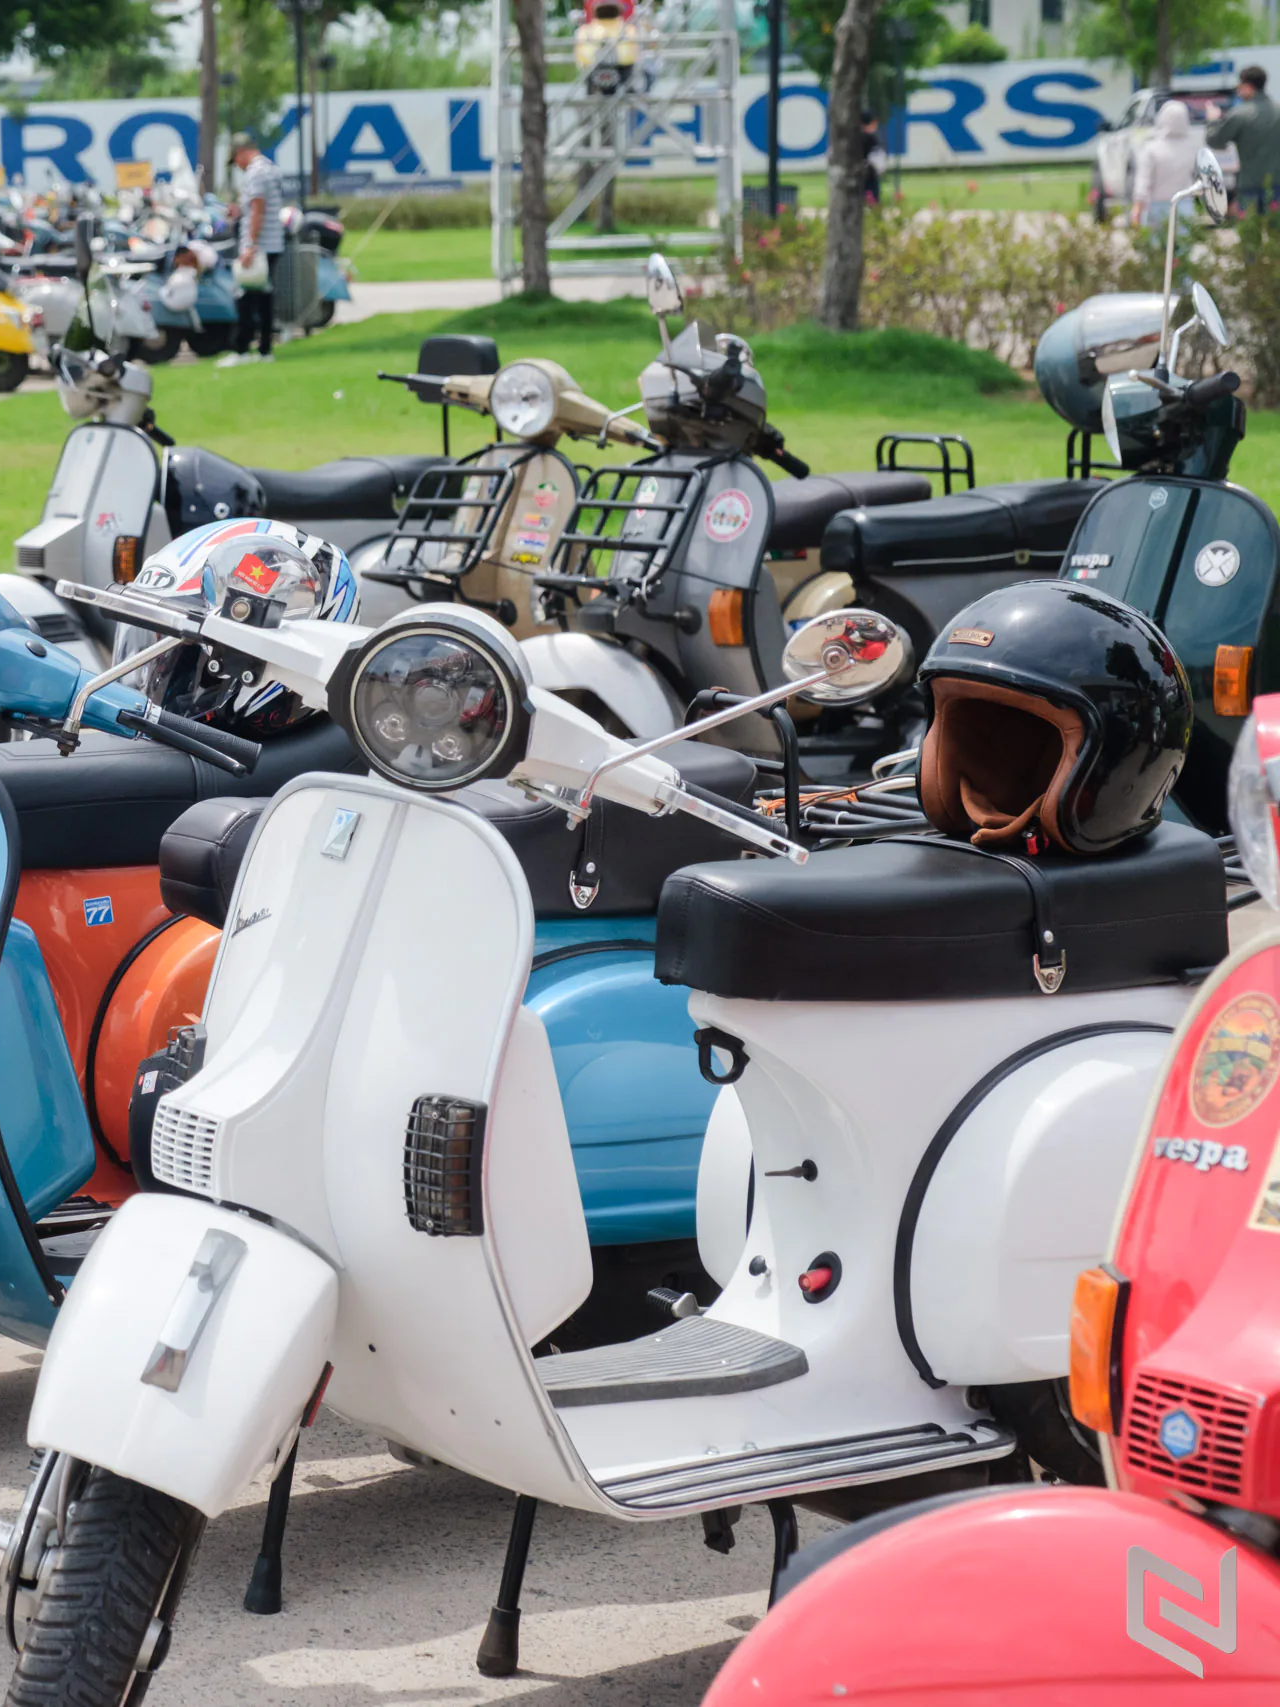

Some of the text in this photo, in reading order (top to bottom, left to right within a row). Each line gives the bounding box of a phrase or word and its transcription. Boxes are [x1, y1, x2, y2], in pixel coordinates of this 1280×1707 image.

[623, 60, 1234, 168] HORS
[86, 905, 110, 924] 77
[1154, 1137, 1248, 1172] vespa
